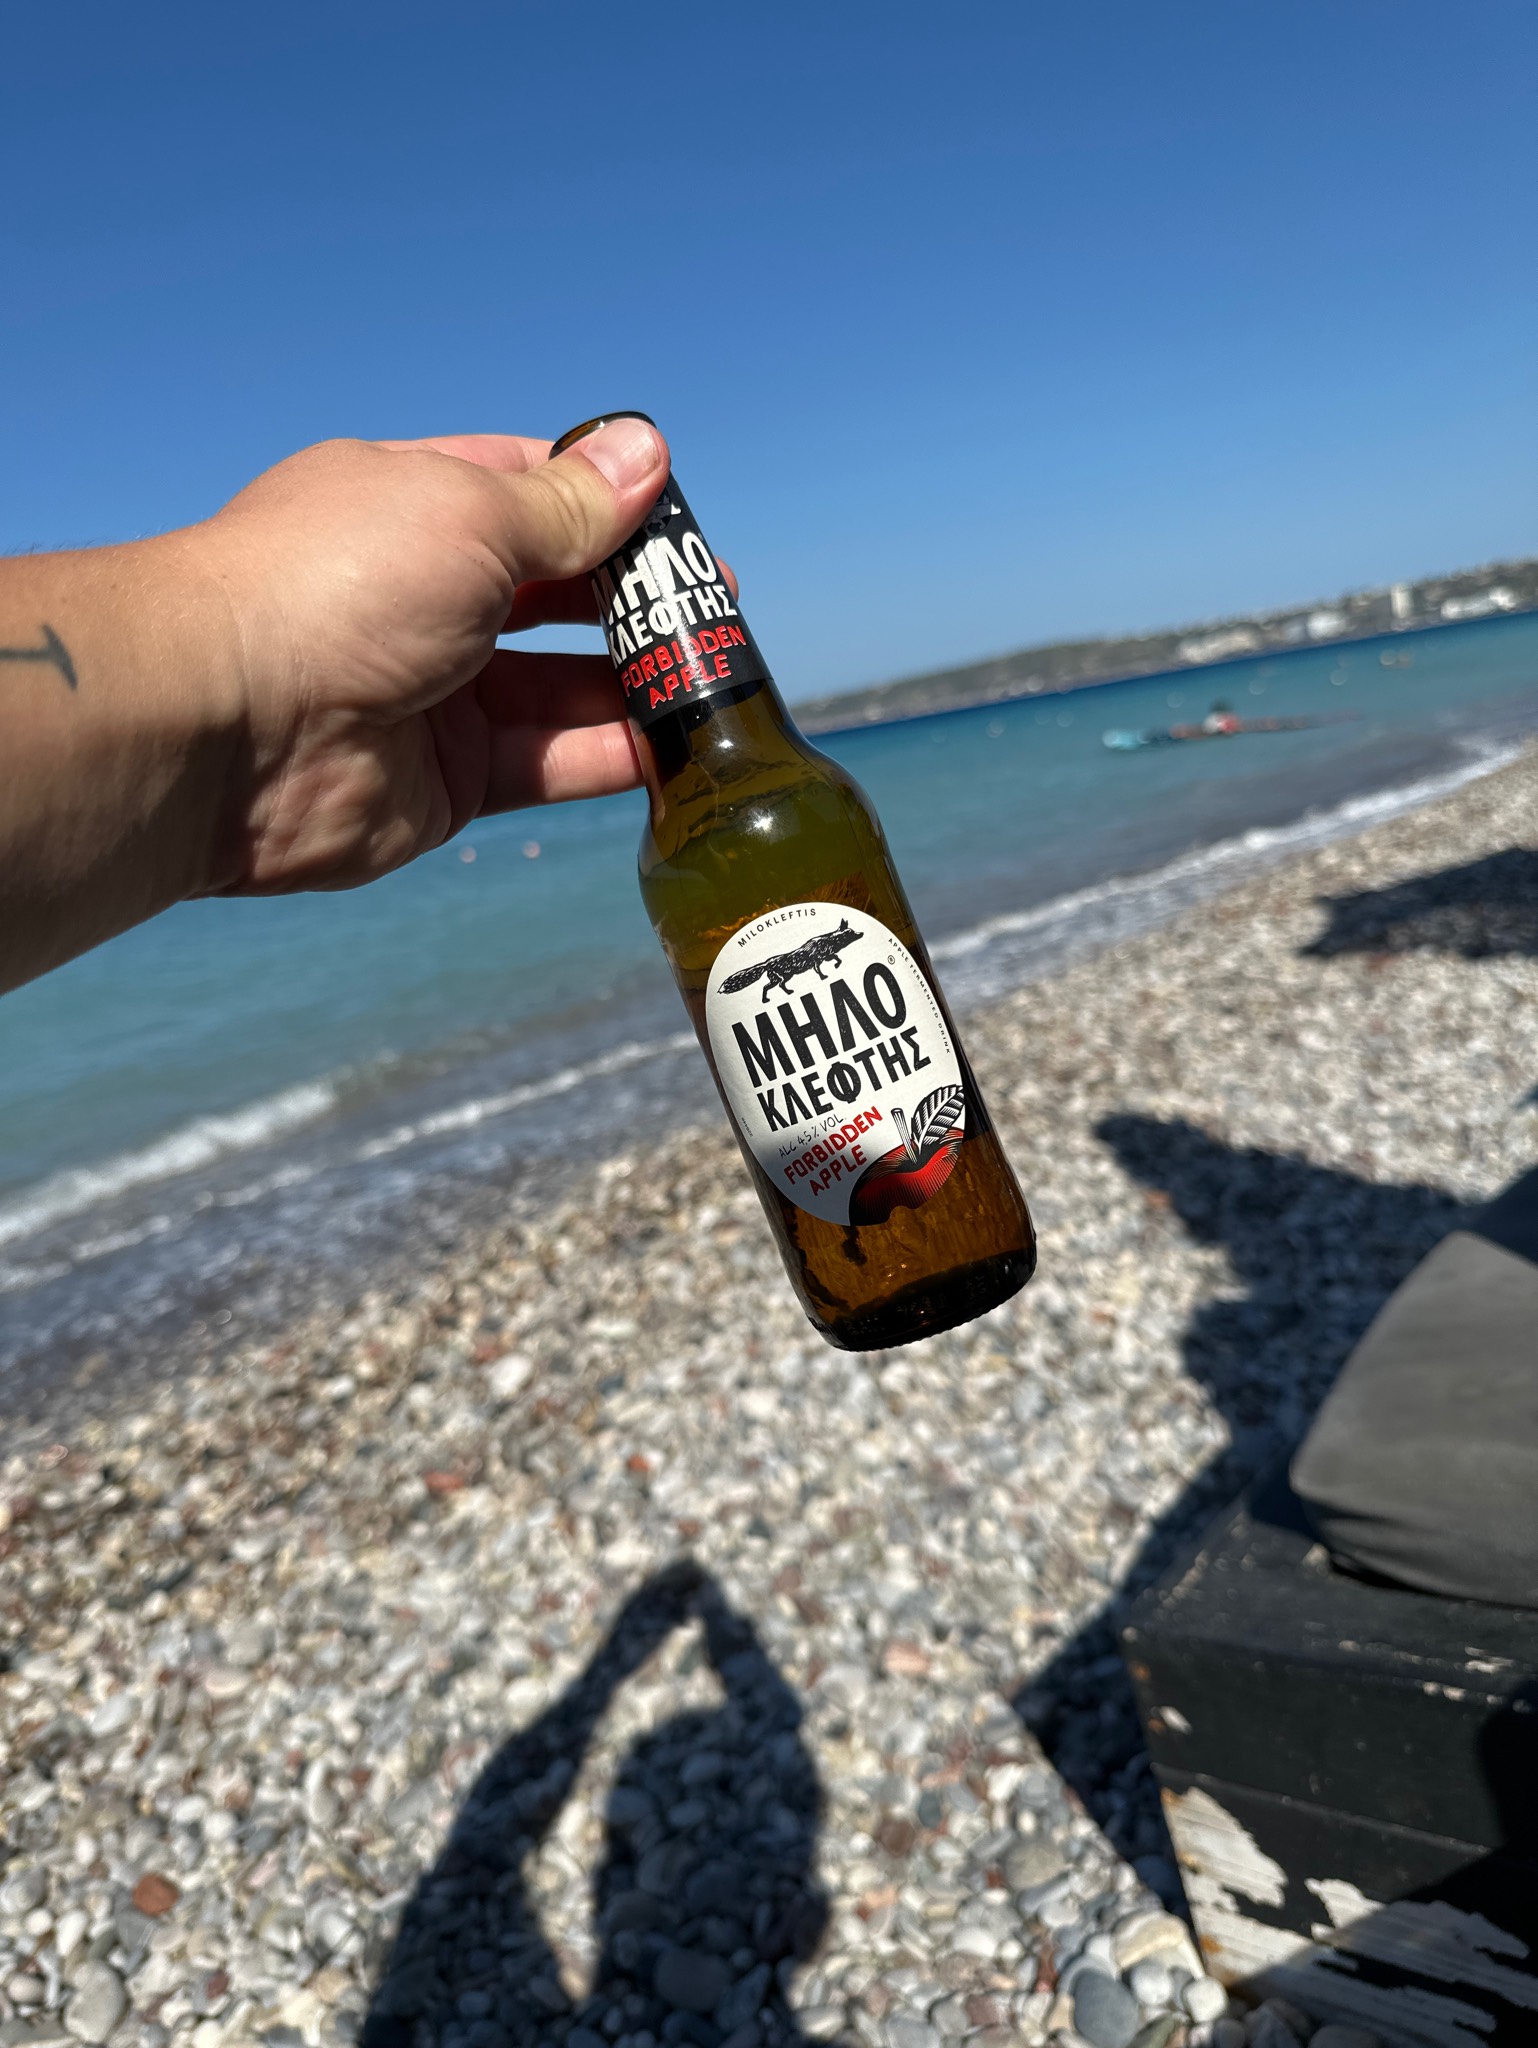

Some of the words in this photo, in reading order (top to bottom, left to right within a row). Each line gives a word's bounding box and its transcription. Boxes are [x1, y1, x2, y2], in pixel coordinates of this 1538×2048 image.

[607, 585, 738, 670] ΚΛΕΦΤΗΣ
[622, 625, 747, 698] FORBIDDEN
[649, 653, 732, 710] APPLE
[737, 908, 817, 948] MILOKLEFTIS
[731, 961, 907, 1089] ΜΗΛΟ
[888, 938, 910, 963] APPLE
[908, 963, 939, 1019] FERMENTED
[937, 1022, 951, 1054] DRINK
[756, 1025, 933, 1133] ΚΛΕΦΤΗΣ
[783, 1105, 884, 1185] FORBIDDEN
[808, 1144, 868, 1197] APPLE
